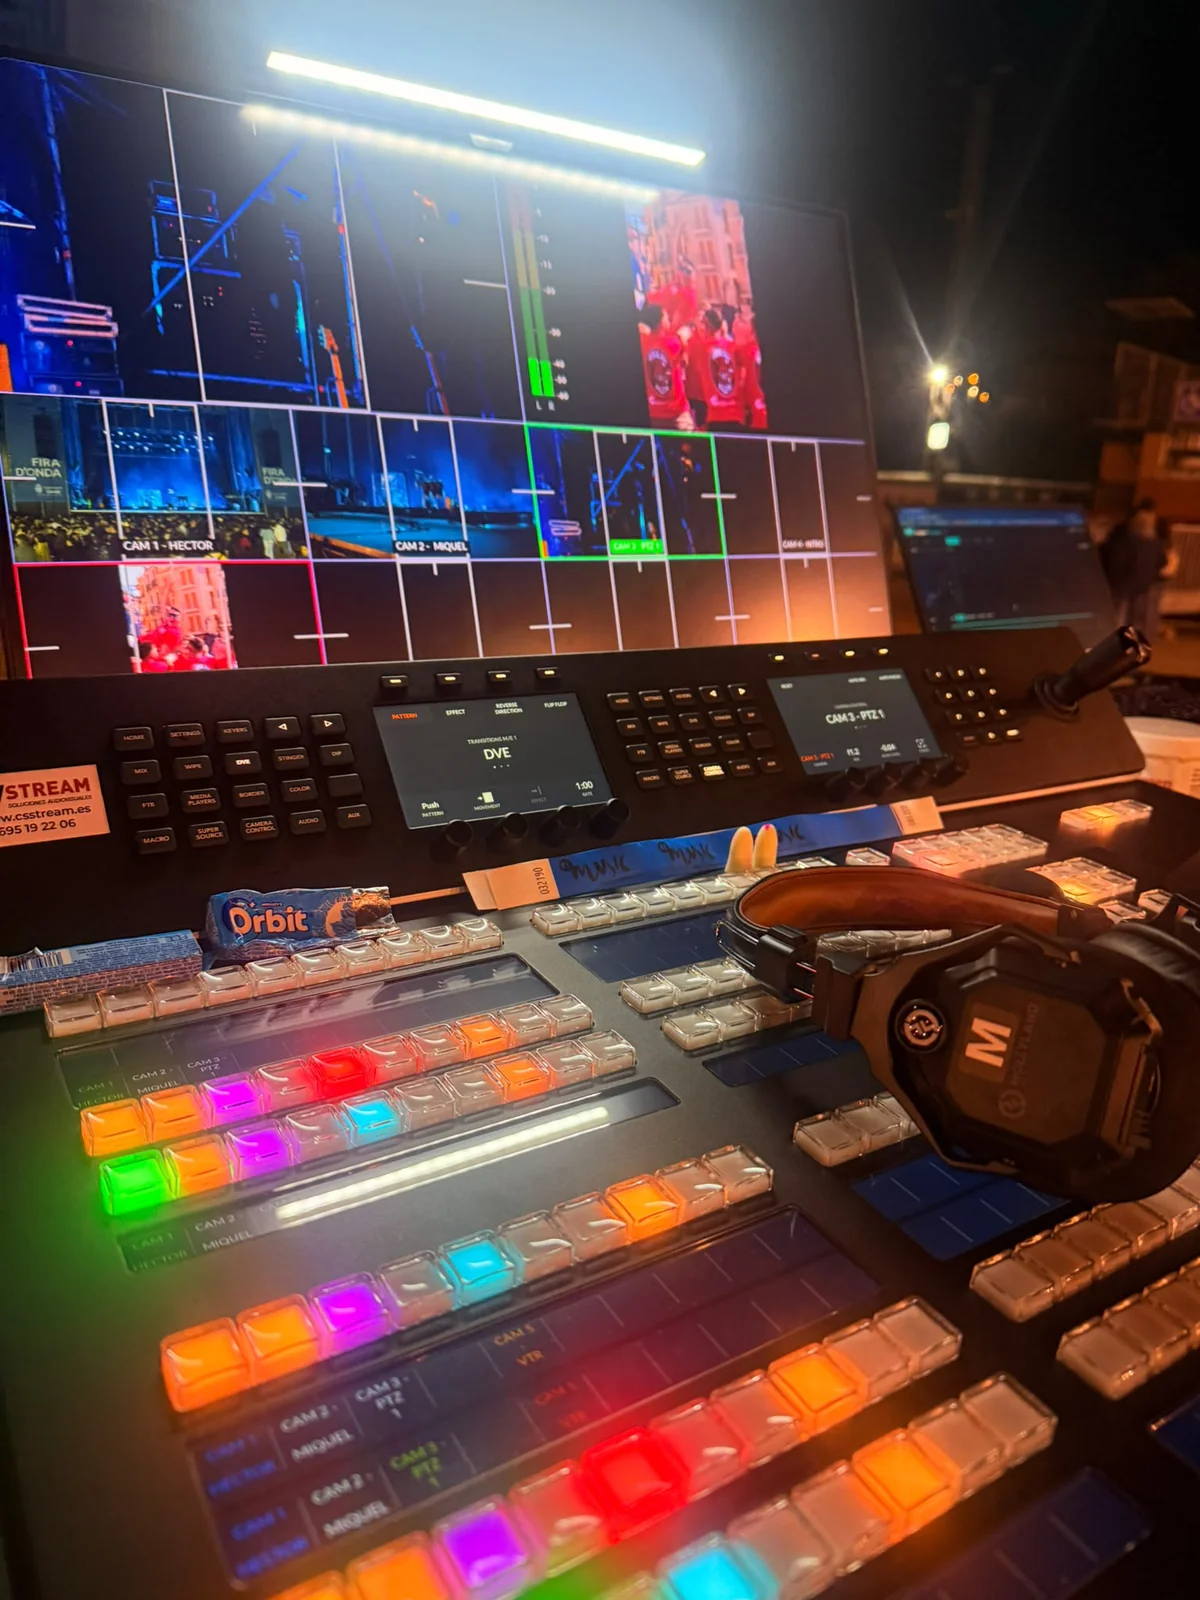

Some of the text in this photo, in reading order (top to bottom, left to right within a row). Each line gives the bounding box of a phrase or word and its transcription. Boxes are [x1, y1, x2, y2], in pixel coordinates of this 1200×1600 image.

[31, 457, 61, 468] FIRA
[15, 466, 62, 478] D'ONDA
[122, 540, 151, 551] CAM
[151, 540, 160, 551] 1
[168, 540, 214, 551] HECTOR
[395, 540, 418, 551] CAM
[418, 541, 426, 552] 2
[432, 540, 469, 553] MIQUEL
[391, 712, 418, 720] PATTERN
[445, 708, 466, 716] EFFECT
[825, 712, 849, 724] CAM
[848, 711, 857, 722] 3
[860, 709, 879, 720] PTZ
[878, 708, 886, 719] 1
[170, 730, 202, 738] SETTINGS
[223, 726, 248, 734] KEYERS
[278, 754, 305, 762] STINGER
[483, 746, 512, 760] DVE
[5, 777, 91, 800] STREAM
[289, 785, 311, 793] COLOR
[575, 780, 594, 791] 1:00
[238, 790, 265, 798] BORDER
[8, 794, 92, 809] SOLUCIONES AUDIOVISUALES
[187, 798, 217, 807] PLAYERS
[421, 800, 440, 810] Push
[0, 805, 92, 823] w.csstream.es
[422, 811, 444, 819] PATTERN
[245, 820, 274, 828] CAMERA
[298, 817, 320, 825] AUDIO
[0, 818, 77, 837] 695 19 22 06
[197, 826, 220, 834] SUPER
[245, 826, 277, 834] CONTROL
[143, 835, 170, 844] MACRO
[195, 832, 224, 841] SOURCE
[532, 867, 550, 895] 032190
[229, 905, 309, 935] Orbit
[965, 1016, 1013, 1069] M
[187, 1058, 214, 1069] CAM
[200, 1063, 221, 1073] PTZ
[132, 1071, 158, 1082] CAM
[159, 1068, 167, 1076] 2
[78, 1082, 105, 1093] CAM
[136, 1079, 181, 1095] MIQUEL
[195, 1216, 226, 1233] CAM
[227, 1213, 236, 1224] 2
[201, 1229, 254, 1252] MIQUEL
[494, 1327, 525, 1347] CAM
[516, 1349, 545, 1367] VTR
[355, 1381, 391, 1402] CAM
[375, 1390, 405, 1411] PTZ
[280, 1409, 319, 1434] CAM
[291, 1428, 355, 1463] MIQUEL
[389, 1446, 428, 1472] CAM
[311, 1478, 351, 1507] CAM
[323, 1500, 390, 1540] MIQUEL
